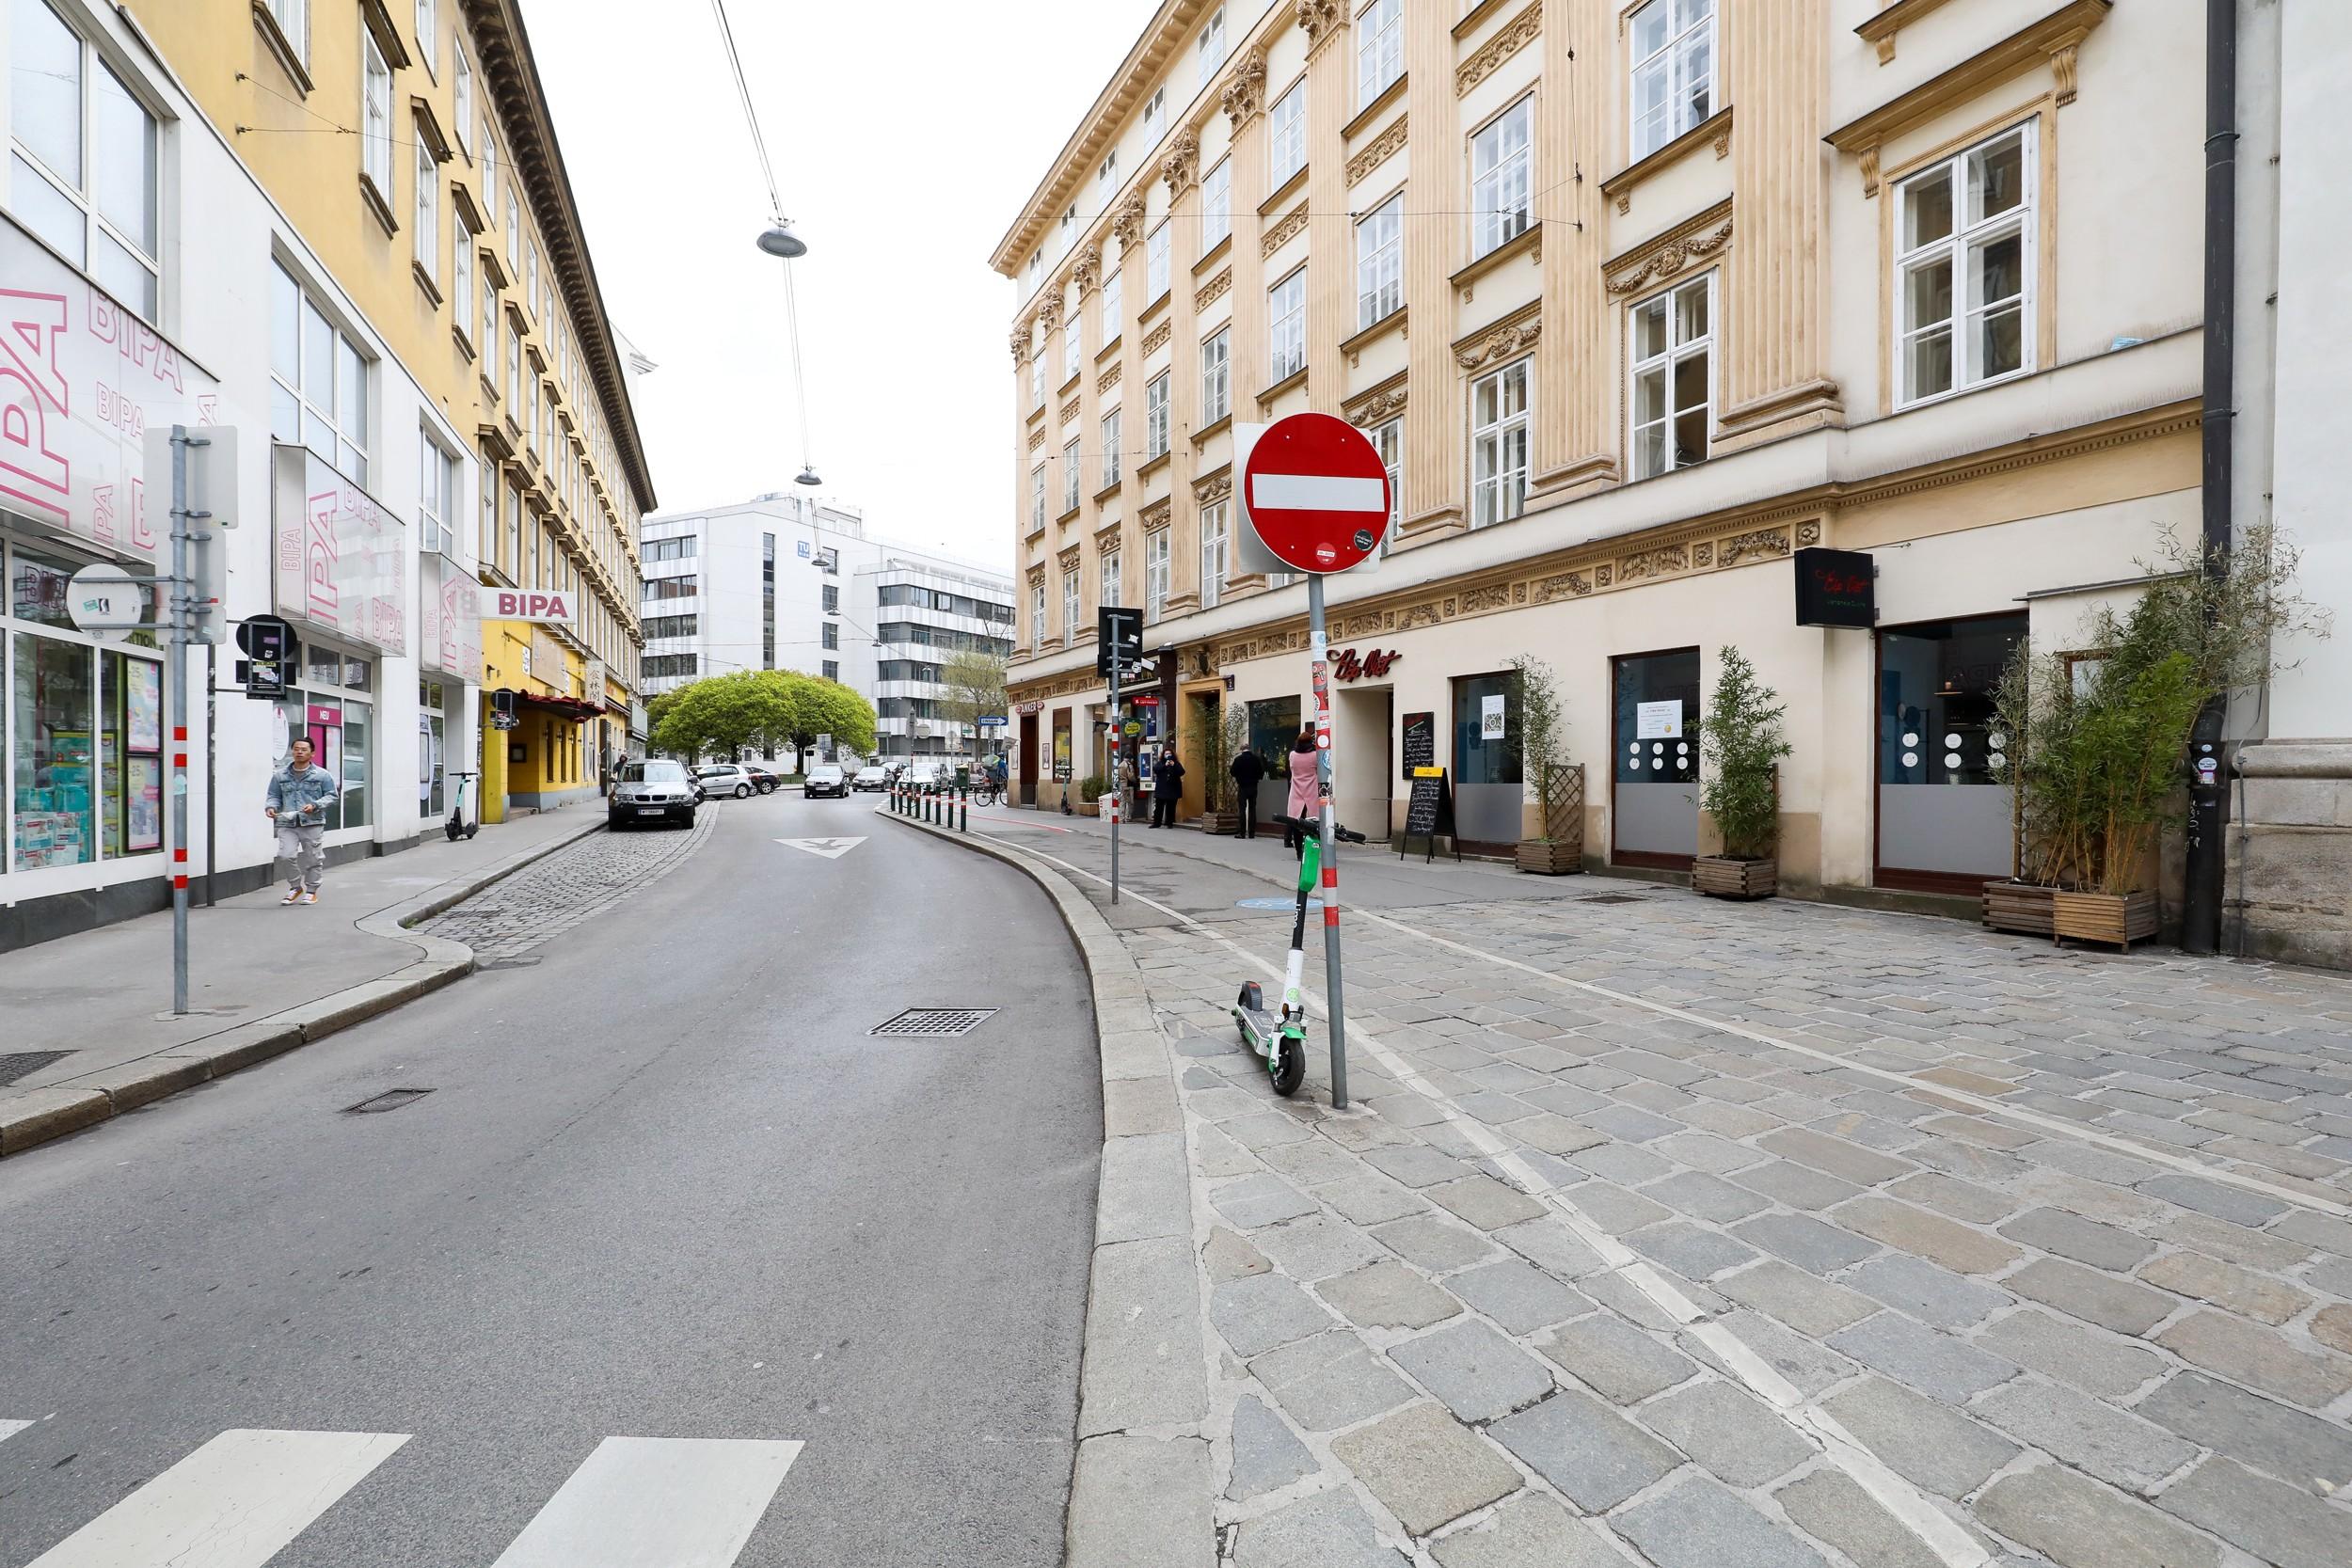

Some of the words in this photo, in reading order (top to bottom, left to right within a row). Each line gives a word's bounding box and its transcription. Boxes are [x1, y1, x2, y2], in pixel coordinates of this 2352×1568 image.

[280, 528, 301, 572] BIPA
[499, 593, 568, 618] BIPA
[320, 710, 330, 721] NEU
[1021, 702, 1037, 714] ANKER
[1293, 903, 1301, 928] Lime
